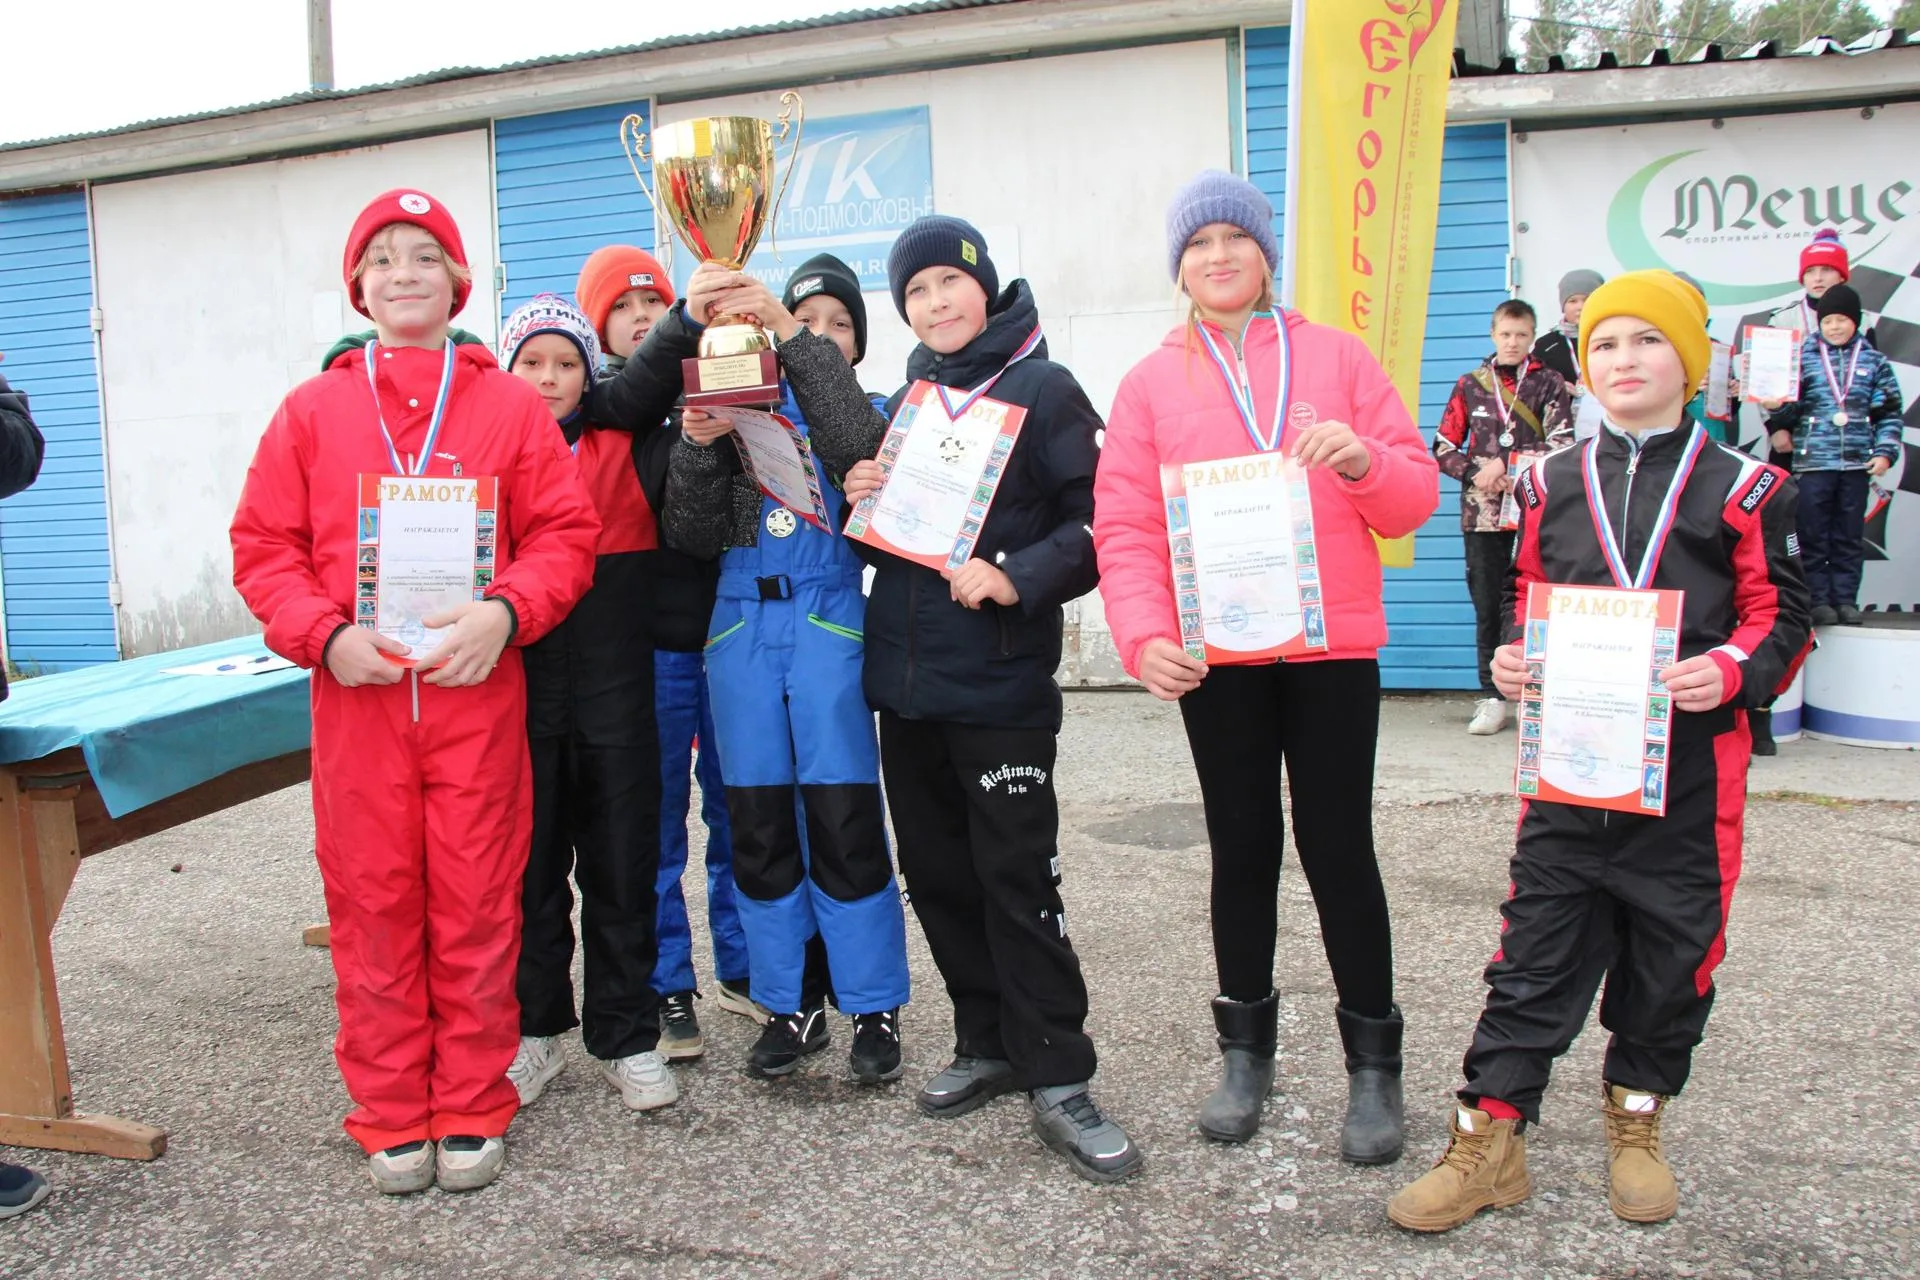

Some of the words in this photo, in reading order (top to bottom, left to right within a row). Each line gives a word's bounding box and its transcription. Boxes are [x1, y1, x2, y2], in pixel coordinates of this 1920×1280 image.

[1180, 459, 1286, 488] ГРАМОТА
[376, 484, 480, 502] ГРАМОТА
[1742, 472, 1775, 510] sparco
[1547, 594, 1660, 619] ГРАМОТА
